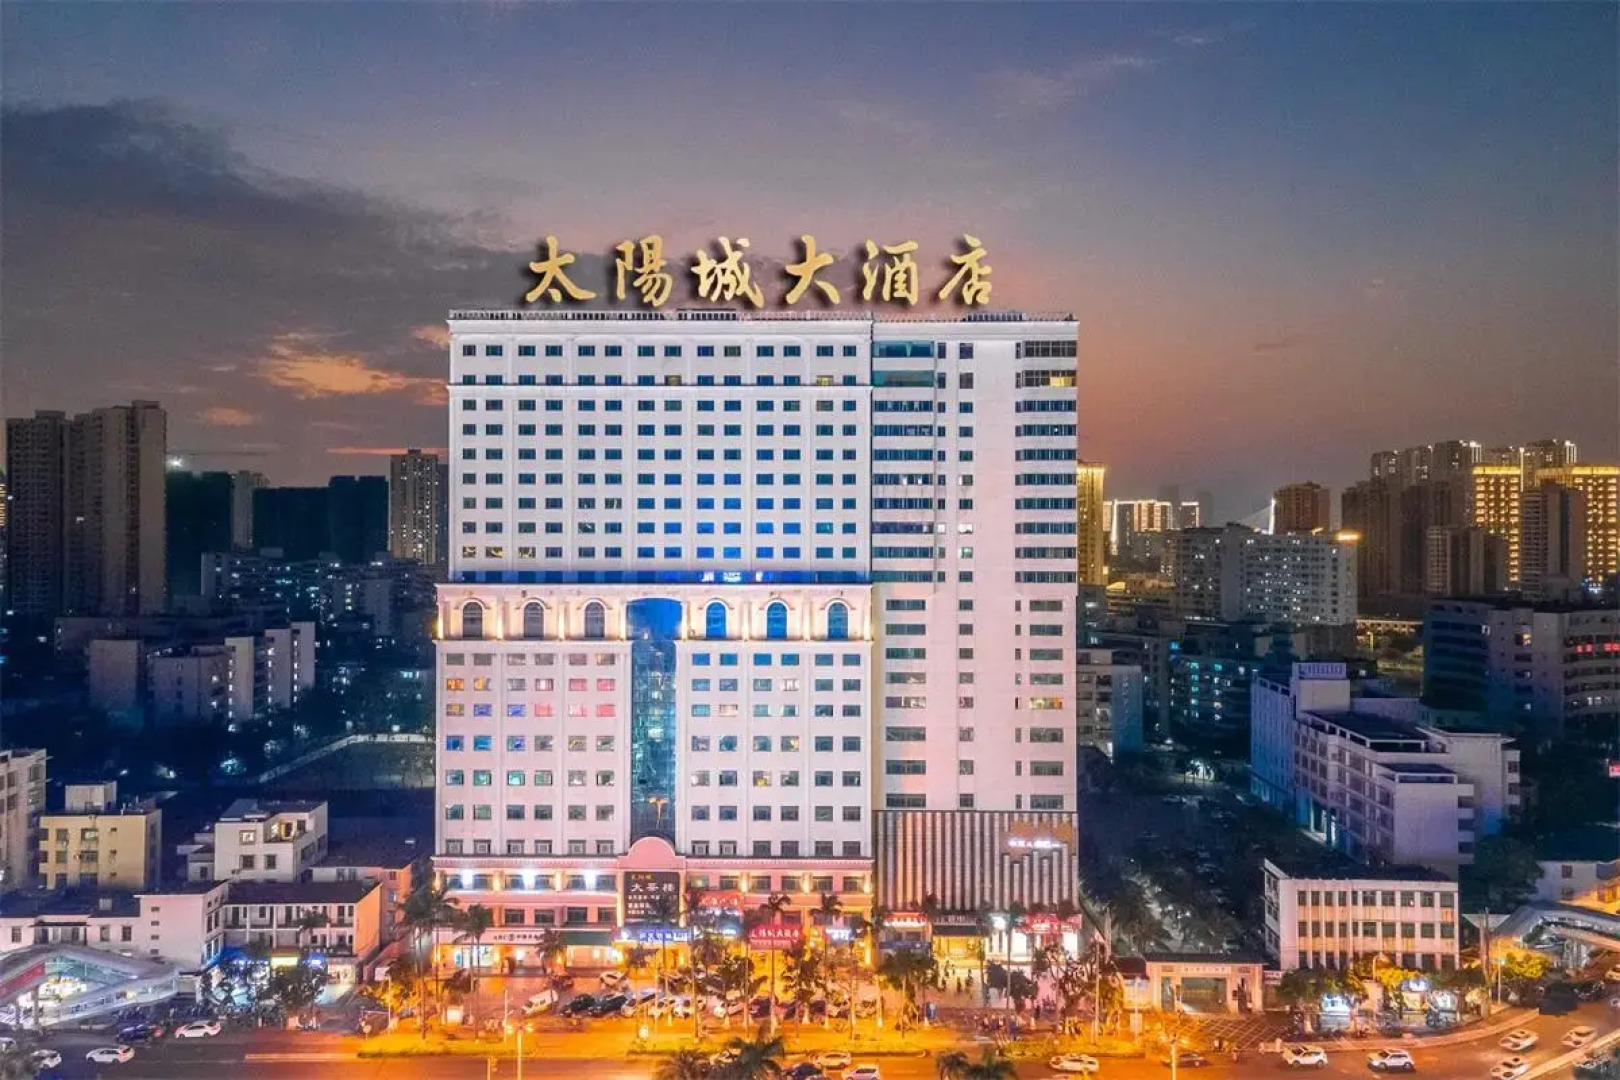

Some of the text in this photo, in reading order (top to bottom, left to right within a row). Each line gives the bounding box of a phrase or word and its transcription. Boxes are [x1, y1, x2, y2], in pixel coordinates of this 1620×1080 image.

[525, 234, 993, 308] 太陽城大酒店
